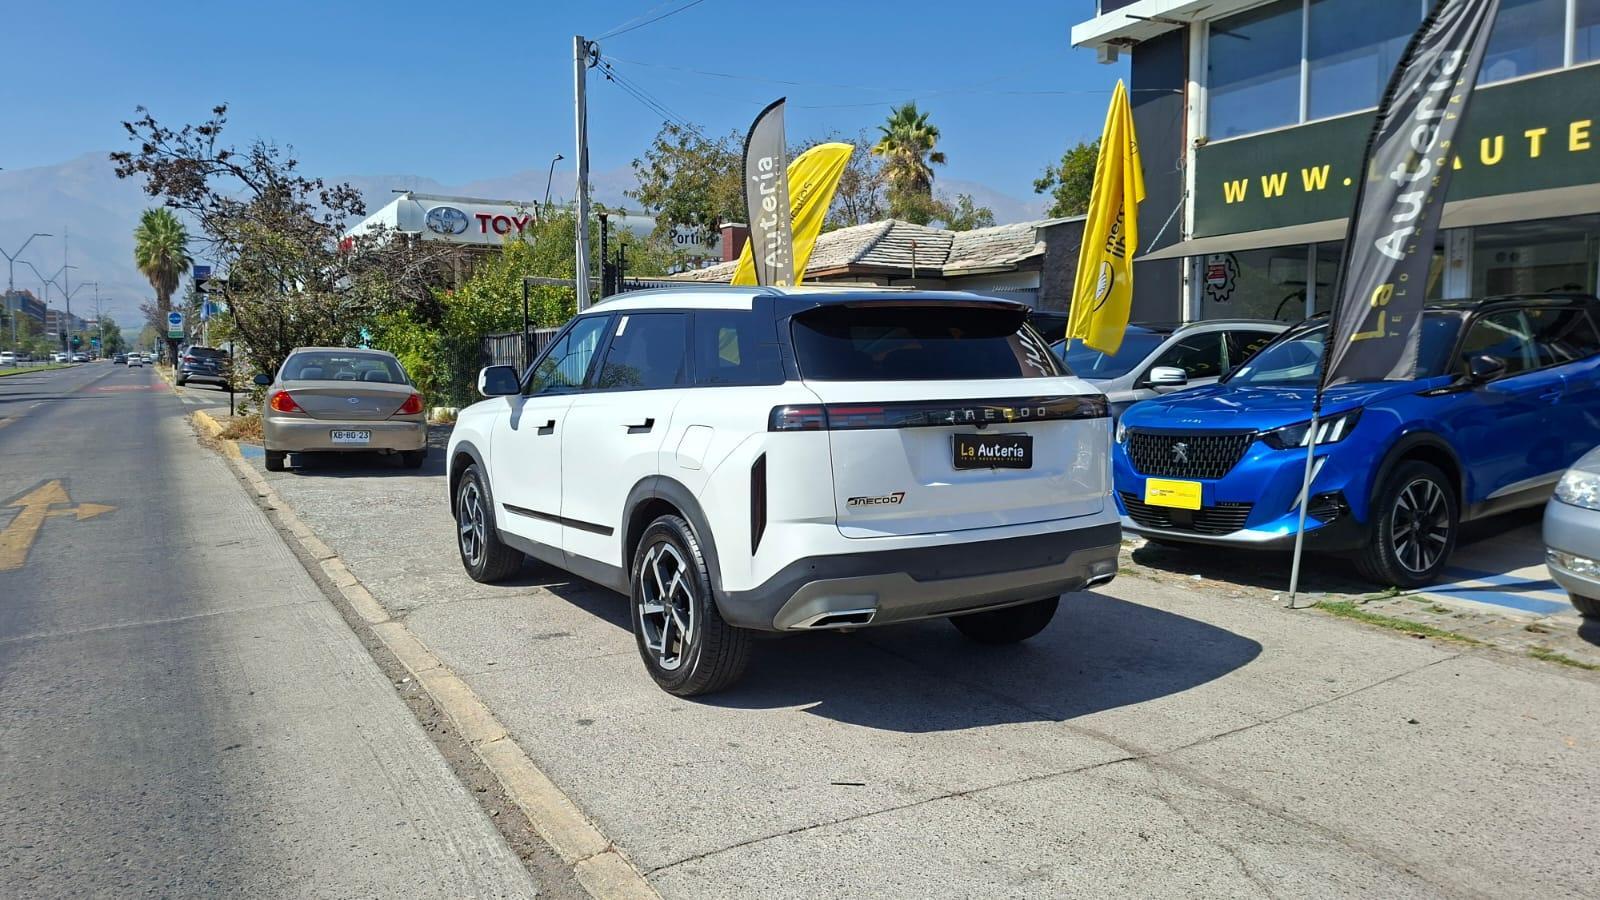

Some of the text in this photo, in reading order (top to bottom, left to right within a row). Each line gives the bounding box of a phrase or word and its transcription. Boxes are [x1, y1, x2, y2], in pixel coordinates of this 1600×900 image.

[475, 213, 533, 235] TOY
[751, 155, 785, 269] Autería
[1351, 282, 1393, 341] La
[961, 442, 1024, 457] La Autería
